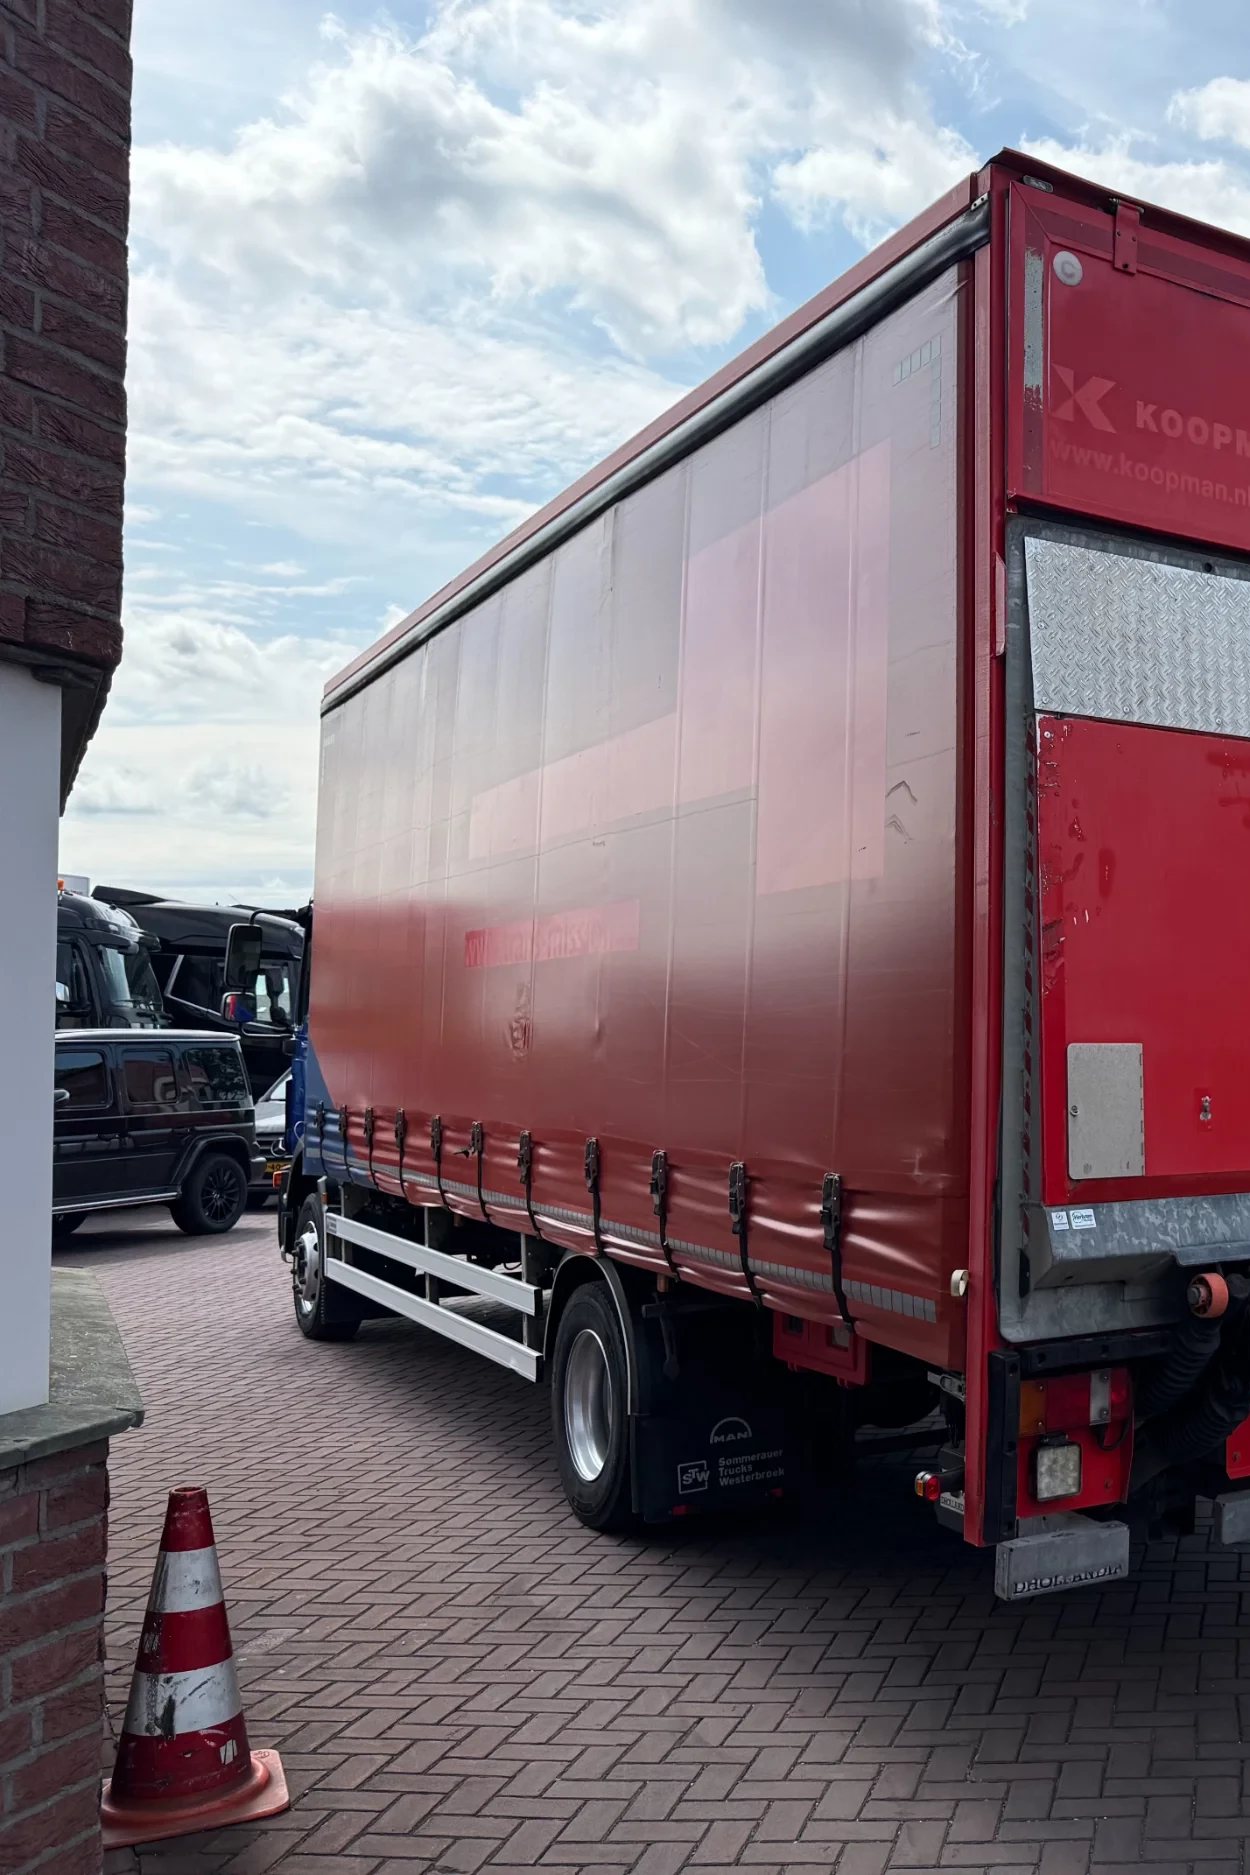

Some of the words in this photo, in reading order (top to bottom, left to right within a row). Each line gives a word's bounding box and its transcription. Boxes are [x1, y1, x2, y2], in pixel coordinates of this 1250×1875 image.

[713, 1431, 749, 1444] MAN
[718, 1448, 784, 1467] Sommerauer
[718, 1464, 753, 1477] Trucks
[719, 1467, 786, 1487] Westerbroek
